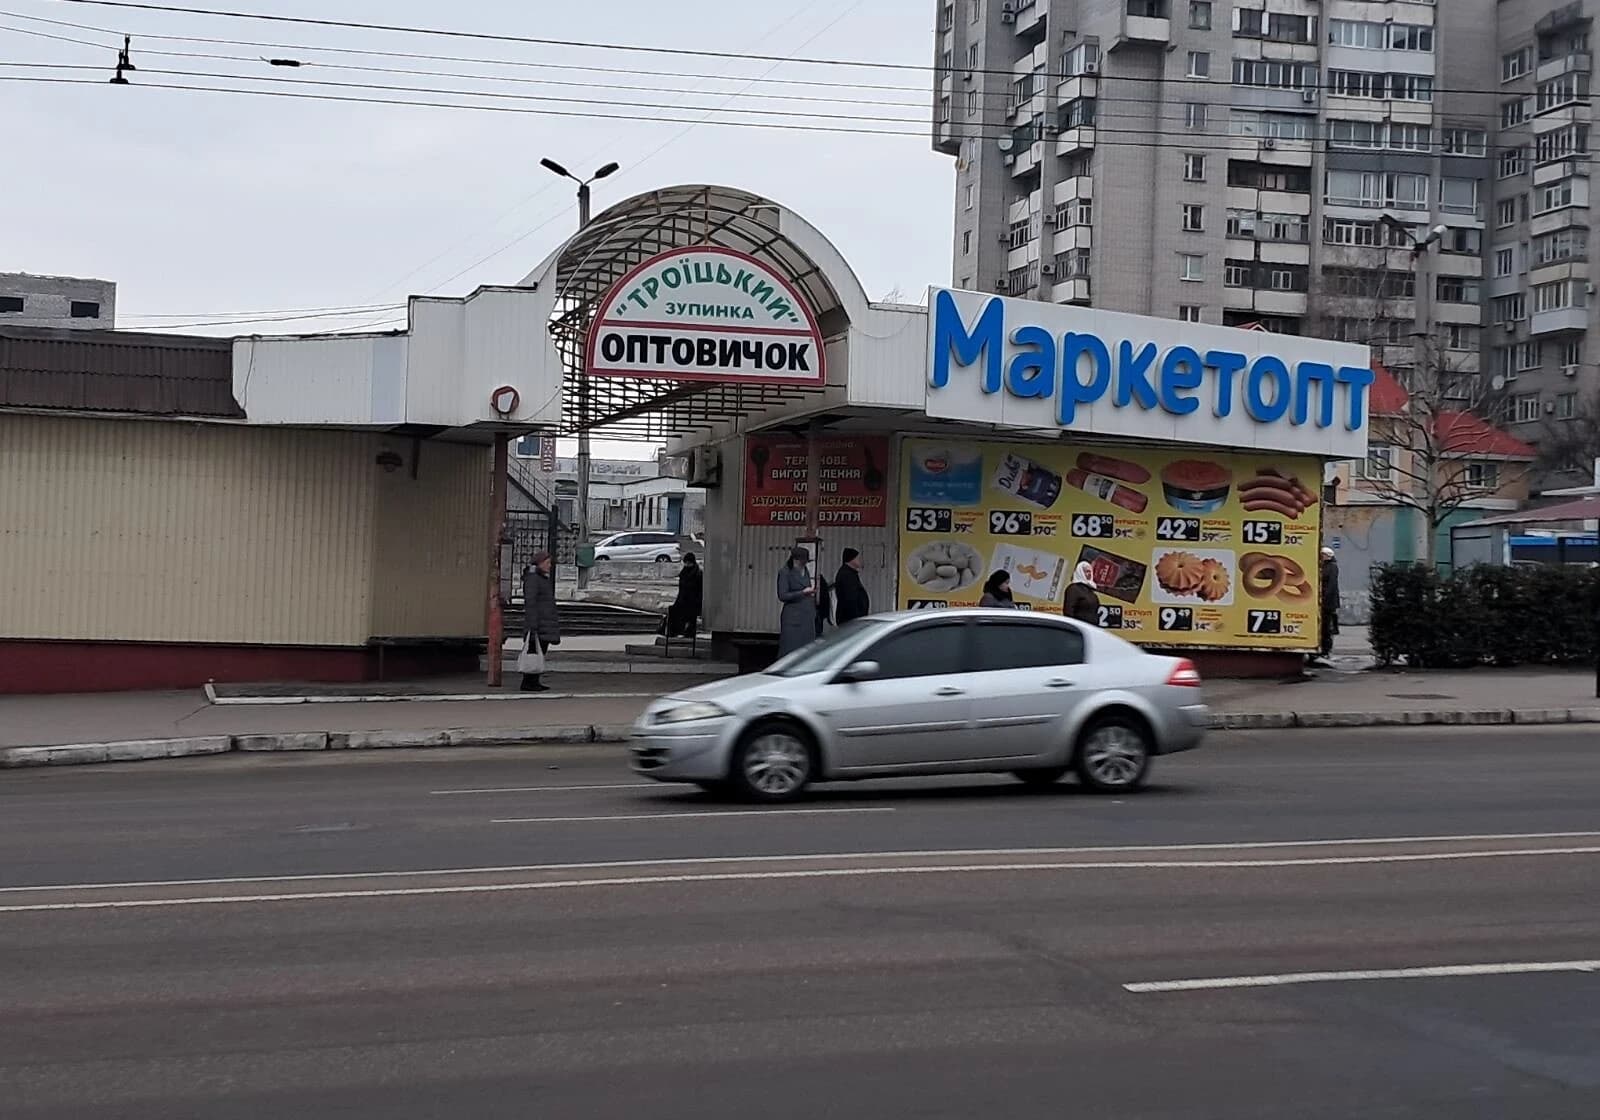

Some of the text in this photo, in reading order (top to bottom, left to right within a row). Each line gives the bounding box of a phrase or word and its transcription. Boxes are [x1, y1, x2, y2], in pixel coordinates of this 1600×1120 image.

[665, 302, 755, 320] ЗУПИНКА
[601, 333, 810, 371] ОПТОВИЧОК
[931, 288, 1375, 430] Маркетопт
[771, 468, 861, 479] ВИГОТЛЕННЯ
[793, 482, 838, 492] КЛЧІВ
[770, 511, 861, 521] РЕМОН ВЗУТТЯ
[908, 509, 938, 531] 53
[991, 511, 1020, 534] 96
[1073, 515, 1101, 537] 68
[1157, 519, 1187, 540] 42
[1243, 522, 1268, 543] 15
[1161, 608, 1177, 629] 9
[1250, 611, 1265, 632] 7
